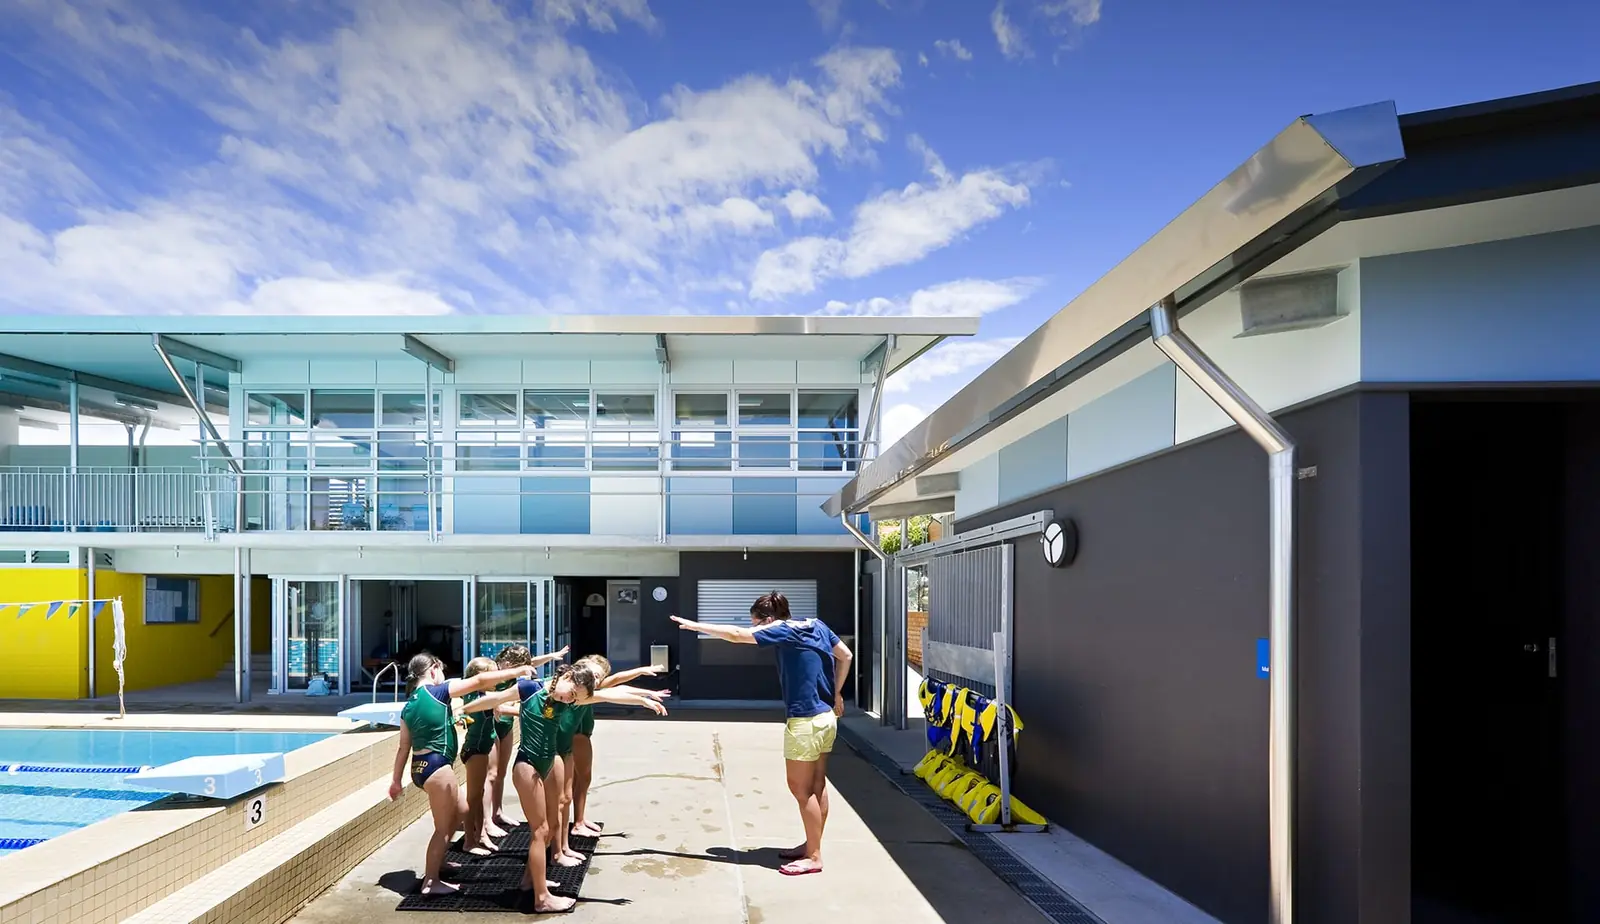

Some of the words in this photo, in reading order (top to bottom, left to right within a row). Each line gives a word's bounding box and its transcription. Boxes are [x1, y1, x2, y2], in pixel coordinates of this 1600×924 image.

[389, 712, 396, 724] 2
[204, 776, 216, 795] 3
[254, 768, 263, 786] 3
[251, 799, 262, 825] 3
